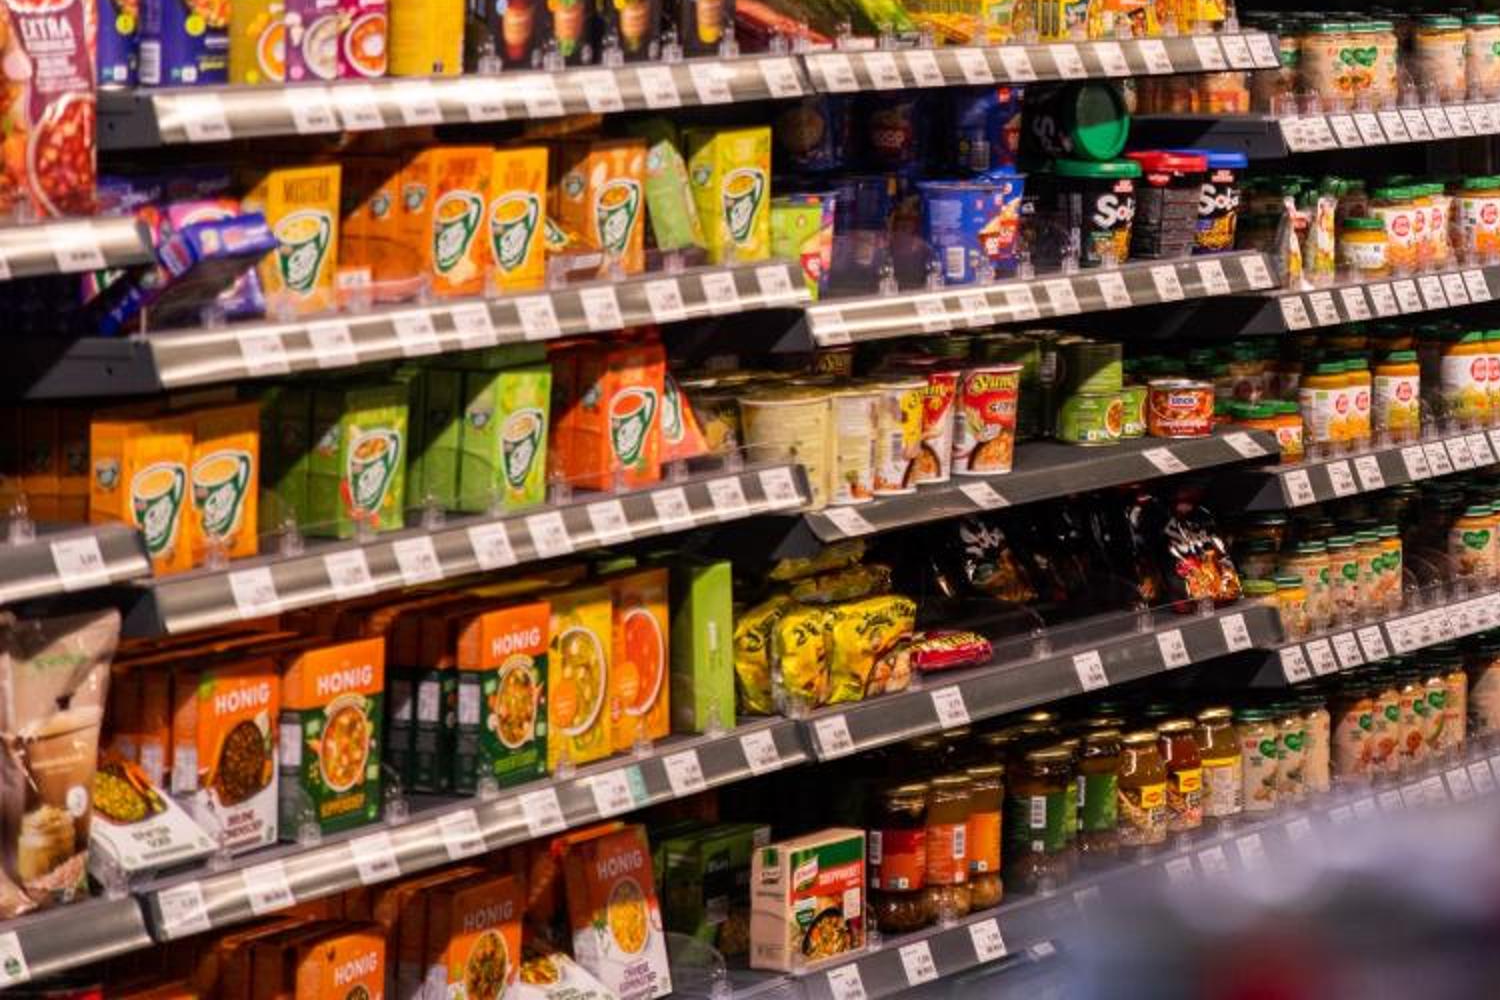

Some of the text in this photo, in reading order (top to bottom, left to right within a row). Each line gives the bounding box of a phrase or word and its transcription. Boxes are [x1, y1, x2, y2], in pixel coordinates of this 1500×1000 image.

[491, 627, 542, 657] HONIG
[317, 665, 373, 695] HONIG
[215, 682, 271, 713] HONIG
[597, 850, 644, 880] HONIG
[464, 902, 513, 932] HONIG
[334, 953, 378, 986] HONIG
